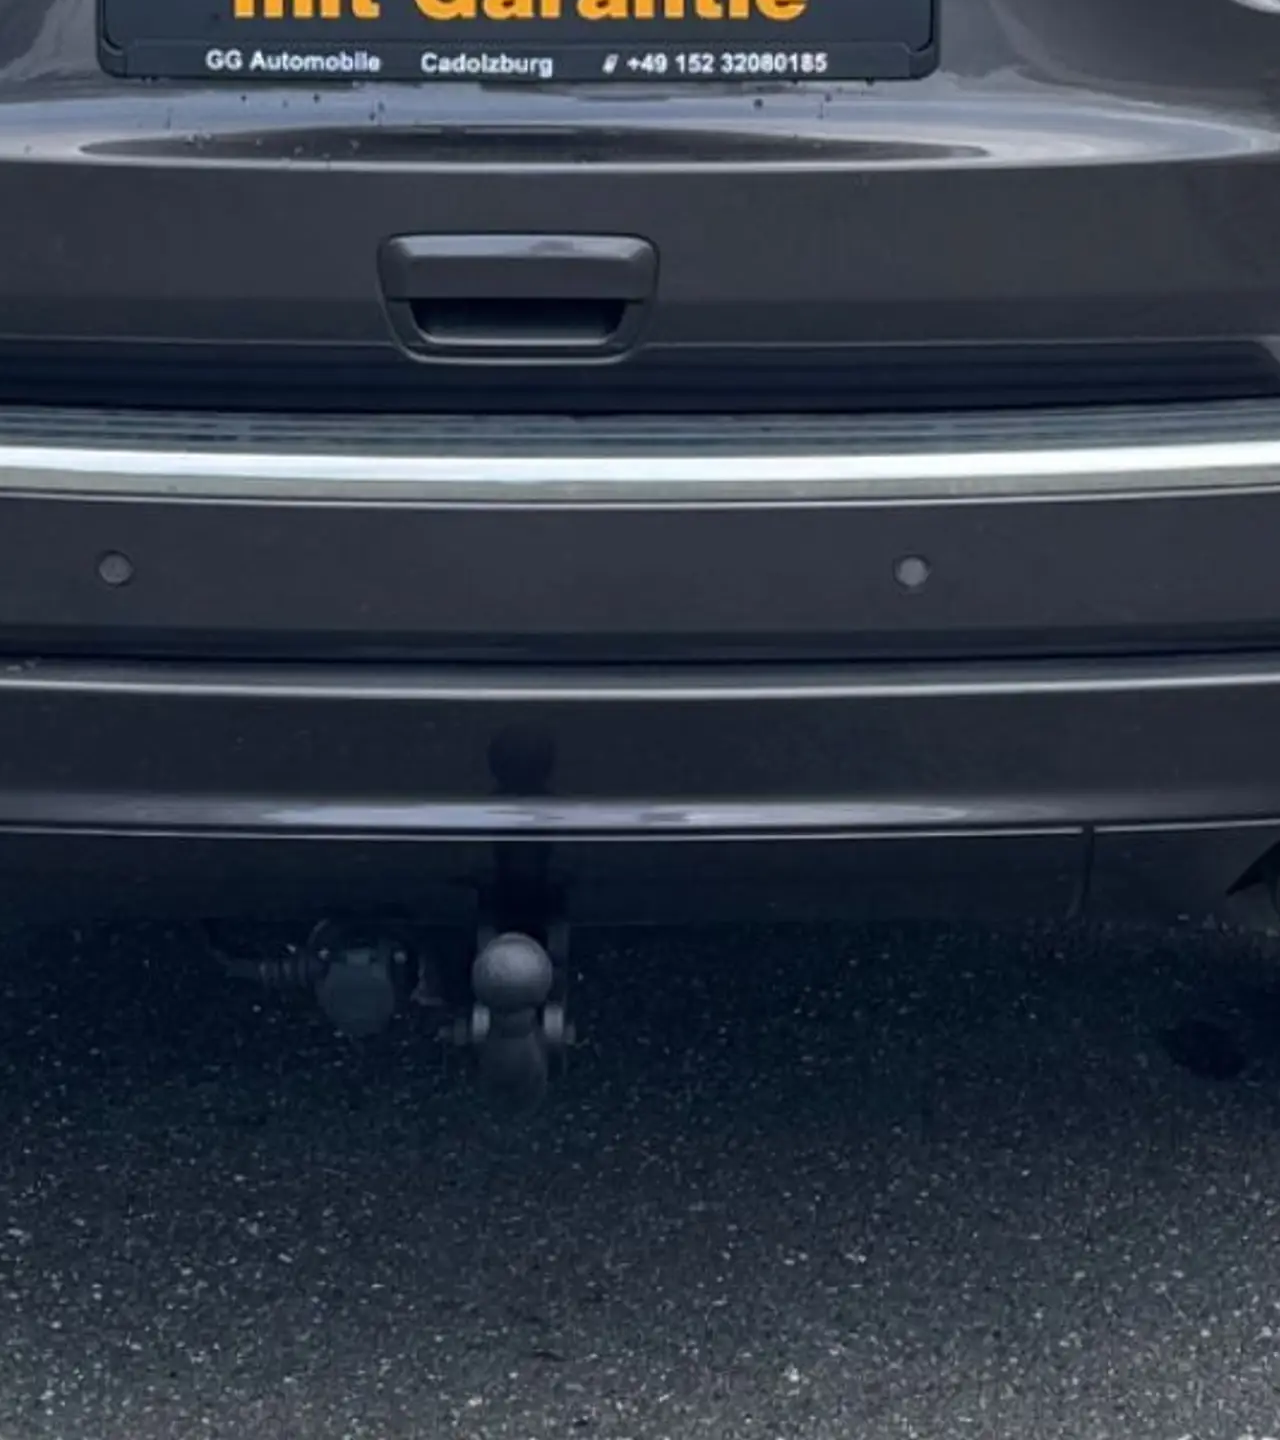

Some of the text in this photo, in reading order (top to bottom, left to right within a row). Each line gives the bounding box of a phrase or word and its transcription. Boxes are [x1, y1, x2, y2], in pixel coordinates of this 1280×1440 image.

[205, 49, 243, 71] GG
[249, 50, 382, 72] Automobile
[420, 51, 554, 78] Cadolzburg
[626, 52, 669, 74] +49
[675, 52, 715, 74] 152
